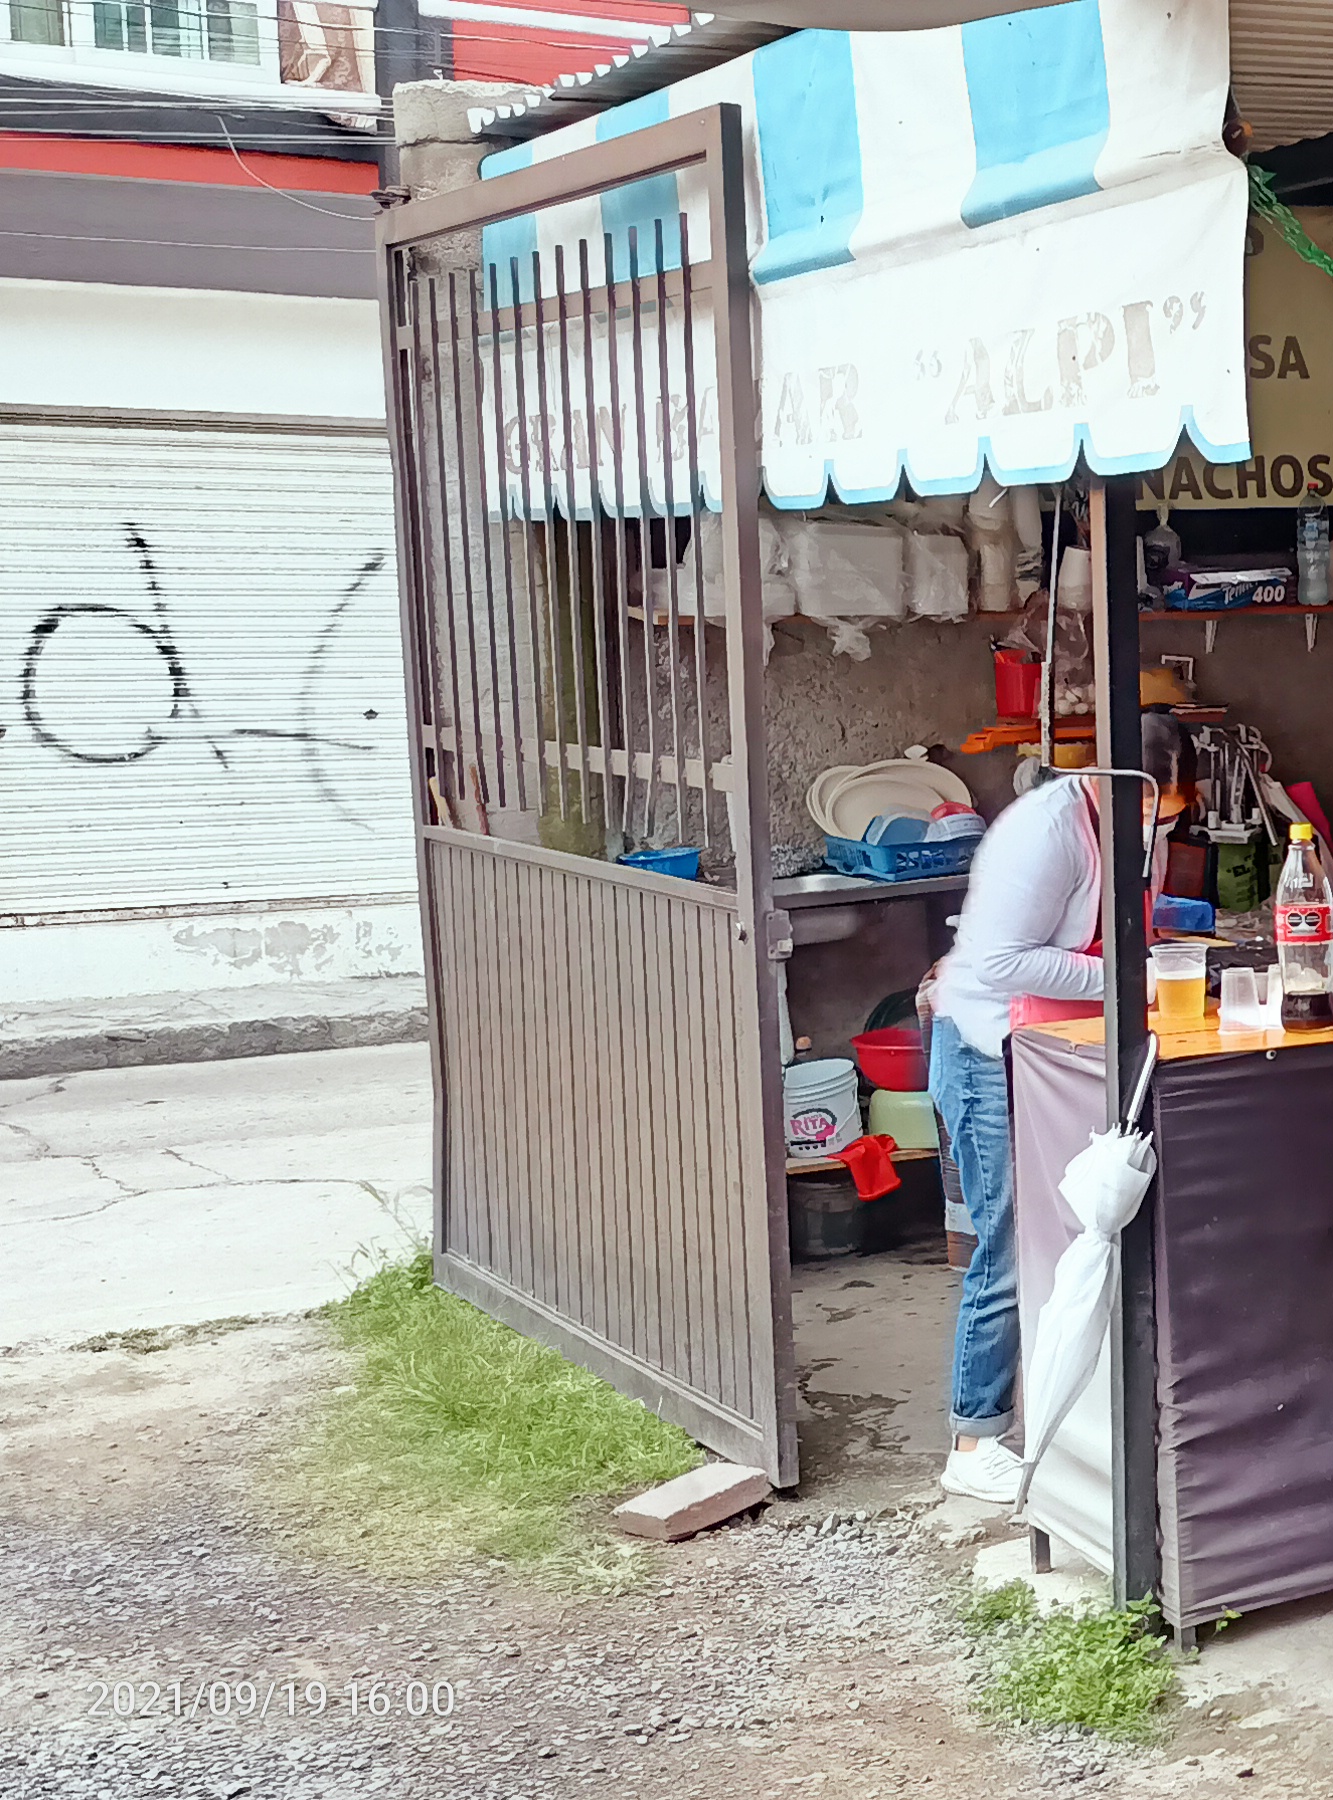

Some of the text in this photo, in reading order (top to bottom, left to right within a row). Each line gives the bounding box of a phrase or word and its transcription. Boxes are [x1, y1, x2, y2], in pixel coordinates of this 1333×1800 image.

[1248, 335, 1310, 379] SA
[1252, 585, 1285, 603] 400
[790, 1117, 829, 1136] RITA
